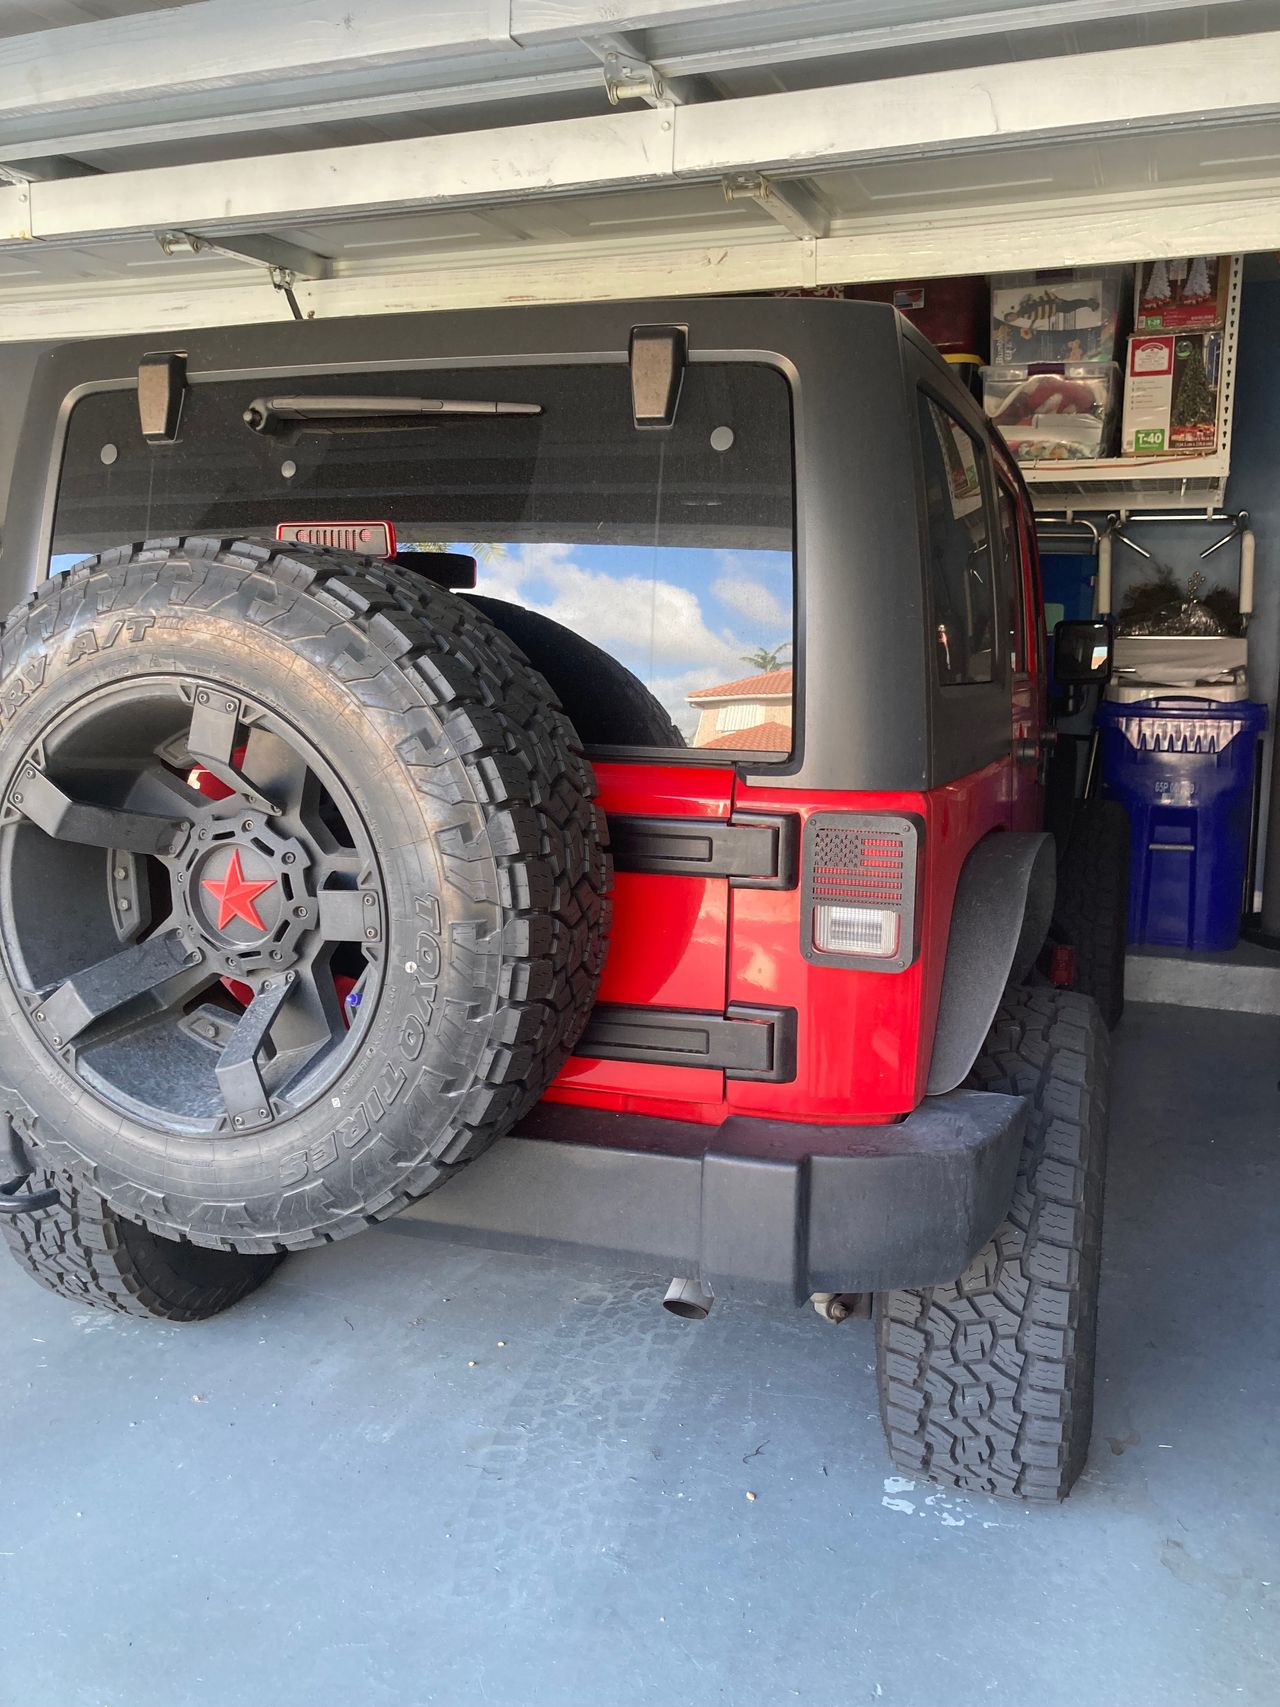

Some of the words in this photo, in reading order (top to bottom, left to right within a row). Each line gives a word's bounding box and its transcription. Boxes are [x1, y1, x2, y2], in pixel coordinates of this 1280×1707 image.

[1137, 432, 1163, 444] T-40
[64, 615, 156, 666] A/T
[400, 892, 442, 1061] TOYO
[279, 1061, 408, 1188] TIRES
